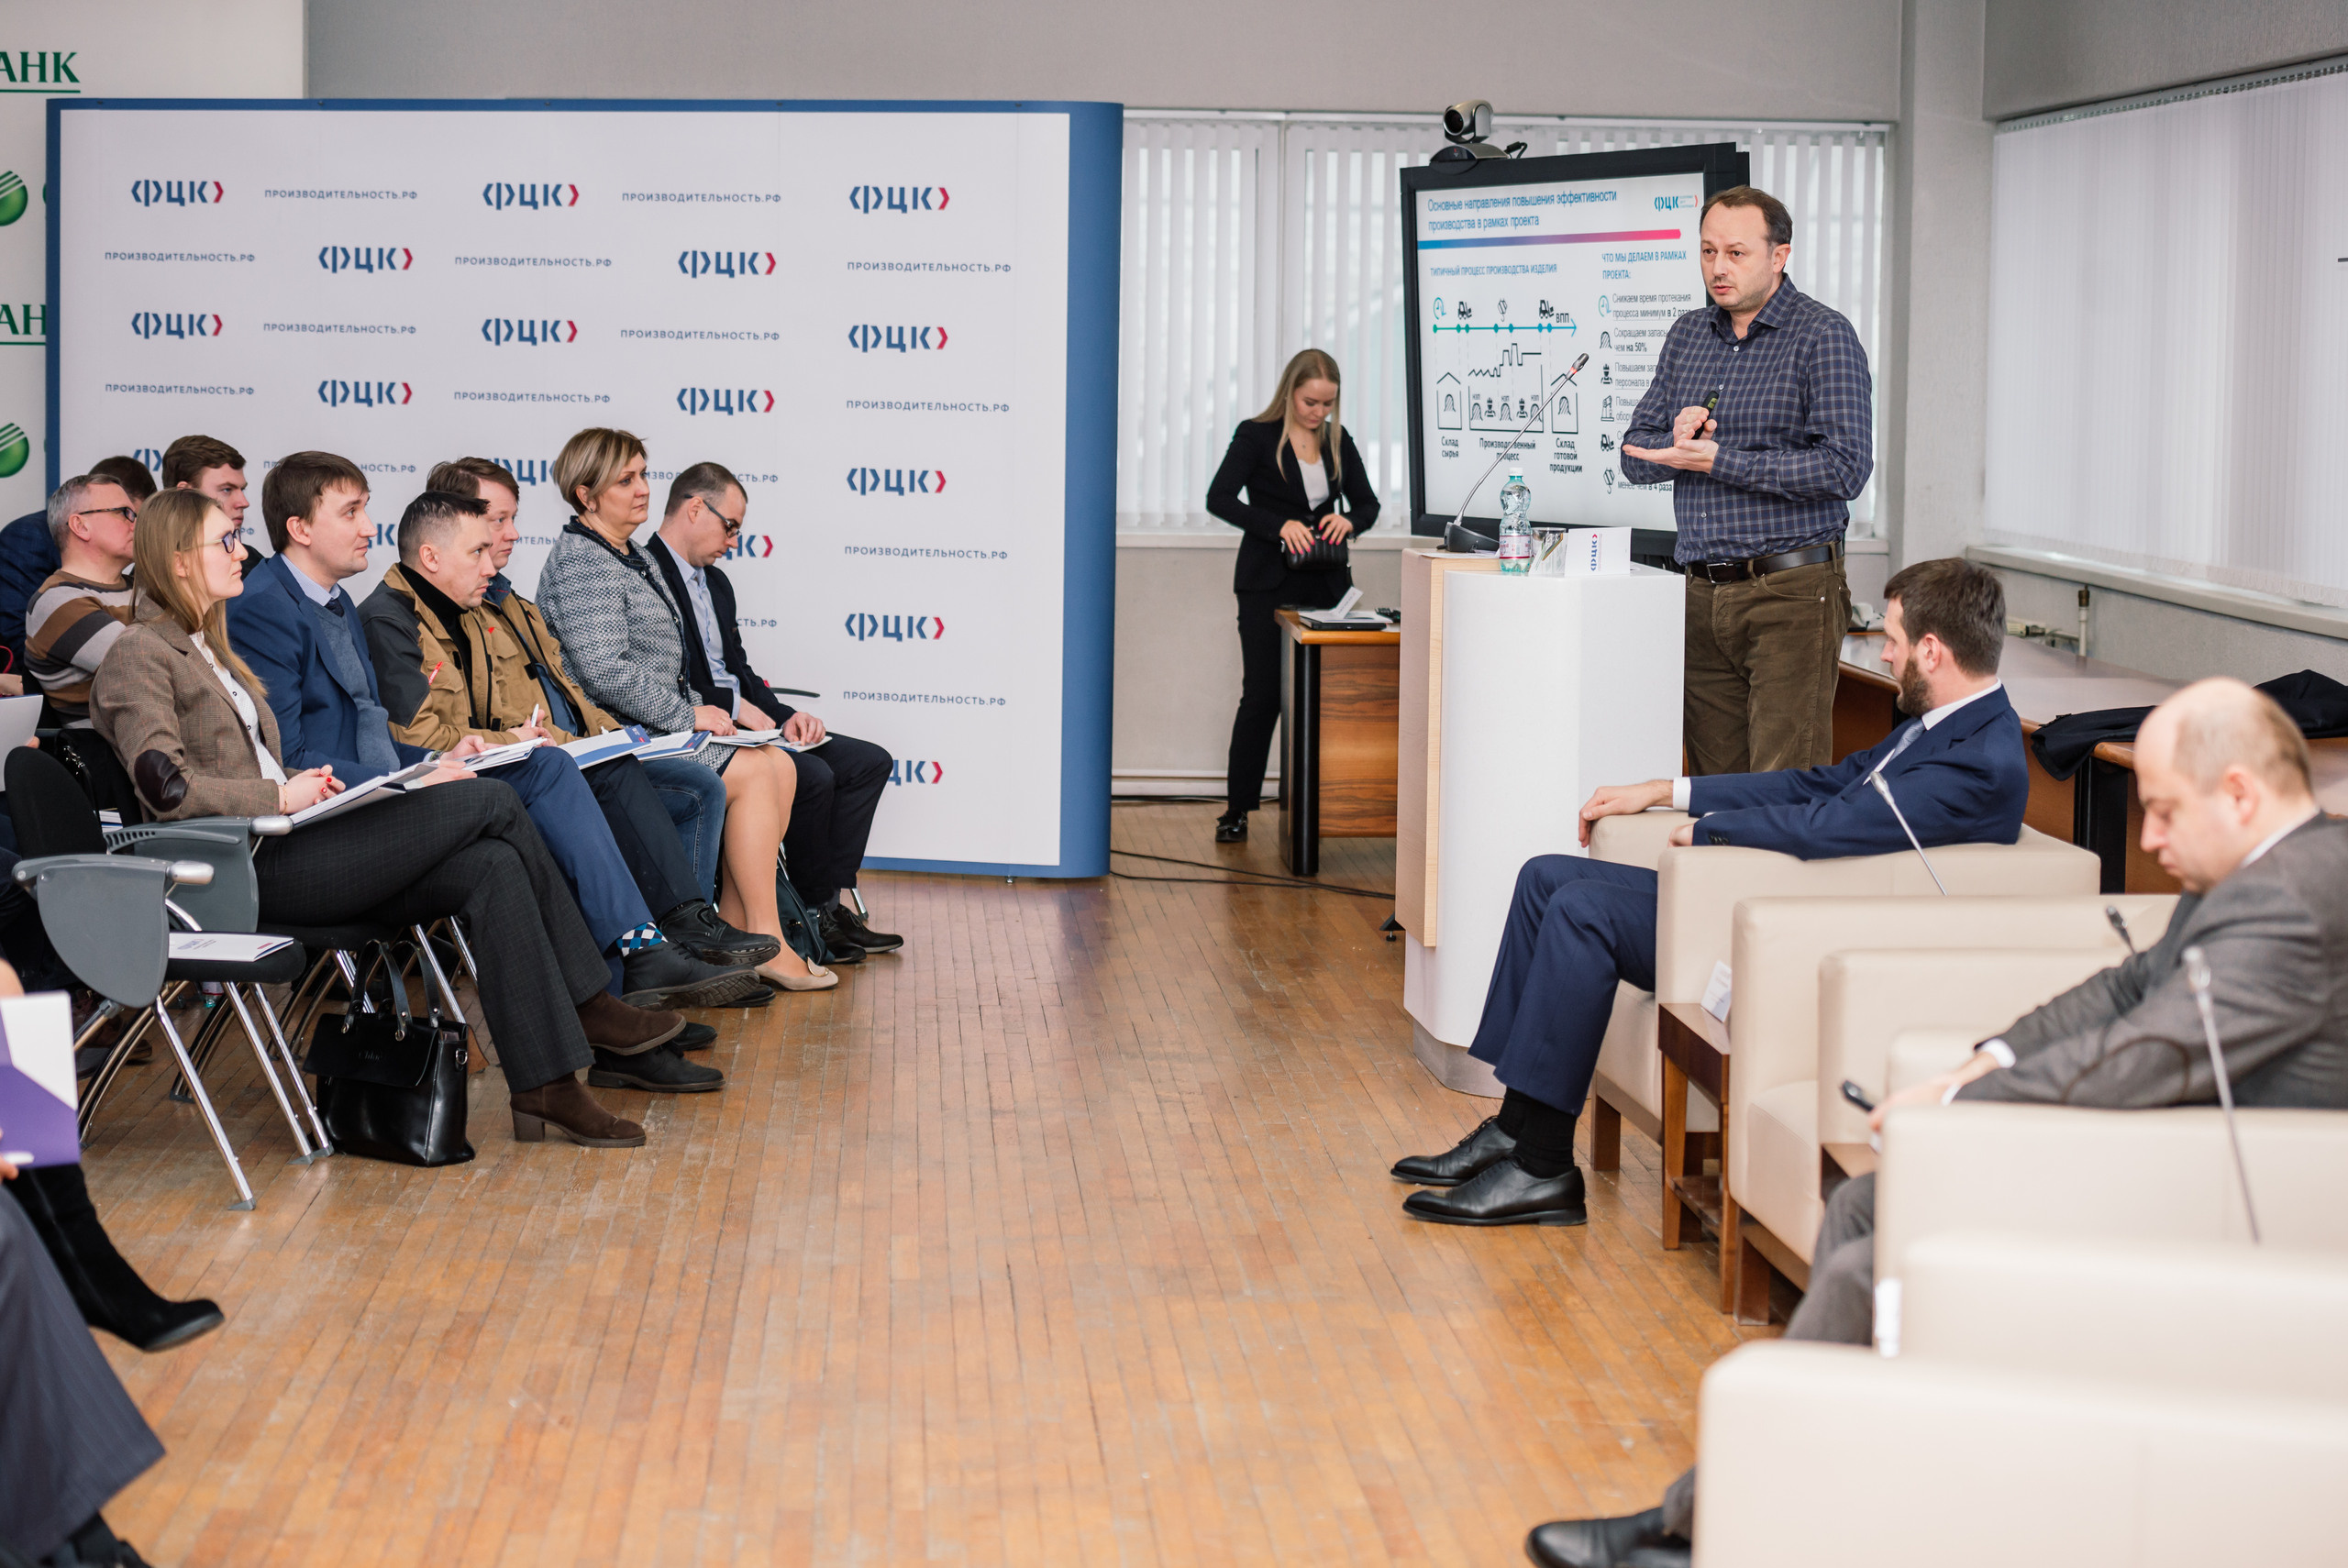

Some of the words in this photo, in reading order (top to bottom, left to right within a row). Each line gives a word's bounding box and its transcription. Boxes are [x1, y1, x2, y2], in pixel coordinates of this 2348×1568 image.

[130, 179, 208, 208] ФЦК
[264, 189, 418, 200] ПРОИЗВОДИТЕЛЬНОСТЬ.РФ
[482, 182, 563, 211] ФЦК
[622, 193, 781, 204] ПРОИЗВОДИТЕЛЬНОСТЬ.РФ
[848, 184, 933, 215] ФЦК
[1427, 198, 1463, 212] Основные
[1465, 196, 1511, 212] направления
[1512, 193, 1555, 207] повышения
[1556, 190, 1617, 208] эффективности
[1428, 219, 1476, 234] производства
[1483, 216, 1509, 231] рамках
[1511, 215, 1540, 230] проекта
[105, 251, 256, 262] ПРОИЗВОДИТЕЛЬНОСТЬ.РФ
[317, 245, 397, 274] ФЦК
[454, 256, 613, 268] ПРОИЗВОДИТЕЛЬНОСТЬ.РФ
[1601, 252, 1613, 263] ЧТО
[1615, 252, 1627, 263] МЫ
[1628, 251, 1654, 264] ДЕЛАЕМ
[1660, 250, 1687, 261] РАМКАХ
[677, 249, 759, 280] ФЦК
[847, 261, 1012, 273] ПРОИЗВОДИТЕЛЬНОСТЬ.РФ
[1461, 266, 1485, 276] ПРОЦЕСС
[1486, 264, 1530, 275] ПРОИЗВОДСТВА
[1531, 263, 1557, 274] ИЗДЕЛИЯ
[1602, 270, 1632, 280] ПРОЕКТА:
[1612, 293, 1638, 304] Снижаем
[1639, 294, 1657, 304] время
[1658, 293, 1691, 304] протекания
[1556, 313, 1569, 323] ВПП
[1612, 310, 1639, 320] процесса
[1640, 310, 1666, 320] минимум
[130, 311, 207, 340] ФЦК
[263, 323, 416, 335] ПРОИЗВОДИТЕЛЬНОСТЬ.РФ
[481, 317, 561, 347] ФЦК
[620, 329, 781, 341] ПРОИЗВОДИТЕЛЬНОСТЬ.РФ
[847, 324, 932, 354] ФЦК
[1614, 327, 1646, 339] Сокращаем
[1634, 342, 1647, 353] 50%
[1614, 362, 1646, 372] Повышаем
[105, 383, 255, 396] ПРОИЗВОДИТЕЛЬНОСТЬ.РФ
[1614, 379, 1646, 389] персонала
[317, 379, 396, 408] ФЦК
[453, 391, 611, 403] ПРОИЗВОДИТЕЛЬНОСТЬ.РФ
[676, 387, 759, 416] ФЦК
[846, 400, 1010, 413] ПРОИЗВОДИТЕЛЬНОСТЬ.РФ
[1441, 436, 1459, 448] Склад
[1556, 437, 1576, 450] Склад
[1441, 449, 1459, 459] сырья
[1553, 450, 1578, 461] готовой
[1549, 463, 1583, 475] продукции
[846, 467, 930, 497] ФЦК
[1658, 483, 1673, 493] раза
[844, 546, 1008, 560] ПРОИЗВОДИТЕЛЬНОСТЬ.РФ
[844, 613, 928, 643] ФЦК
[843, 690, 1006, 706] ПРОИЗВОДИТЕЛЬНОСТЬ.РФ
[888, 759, 926, 786] ЦК
